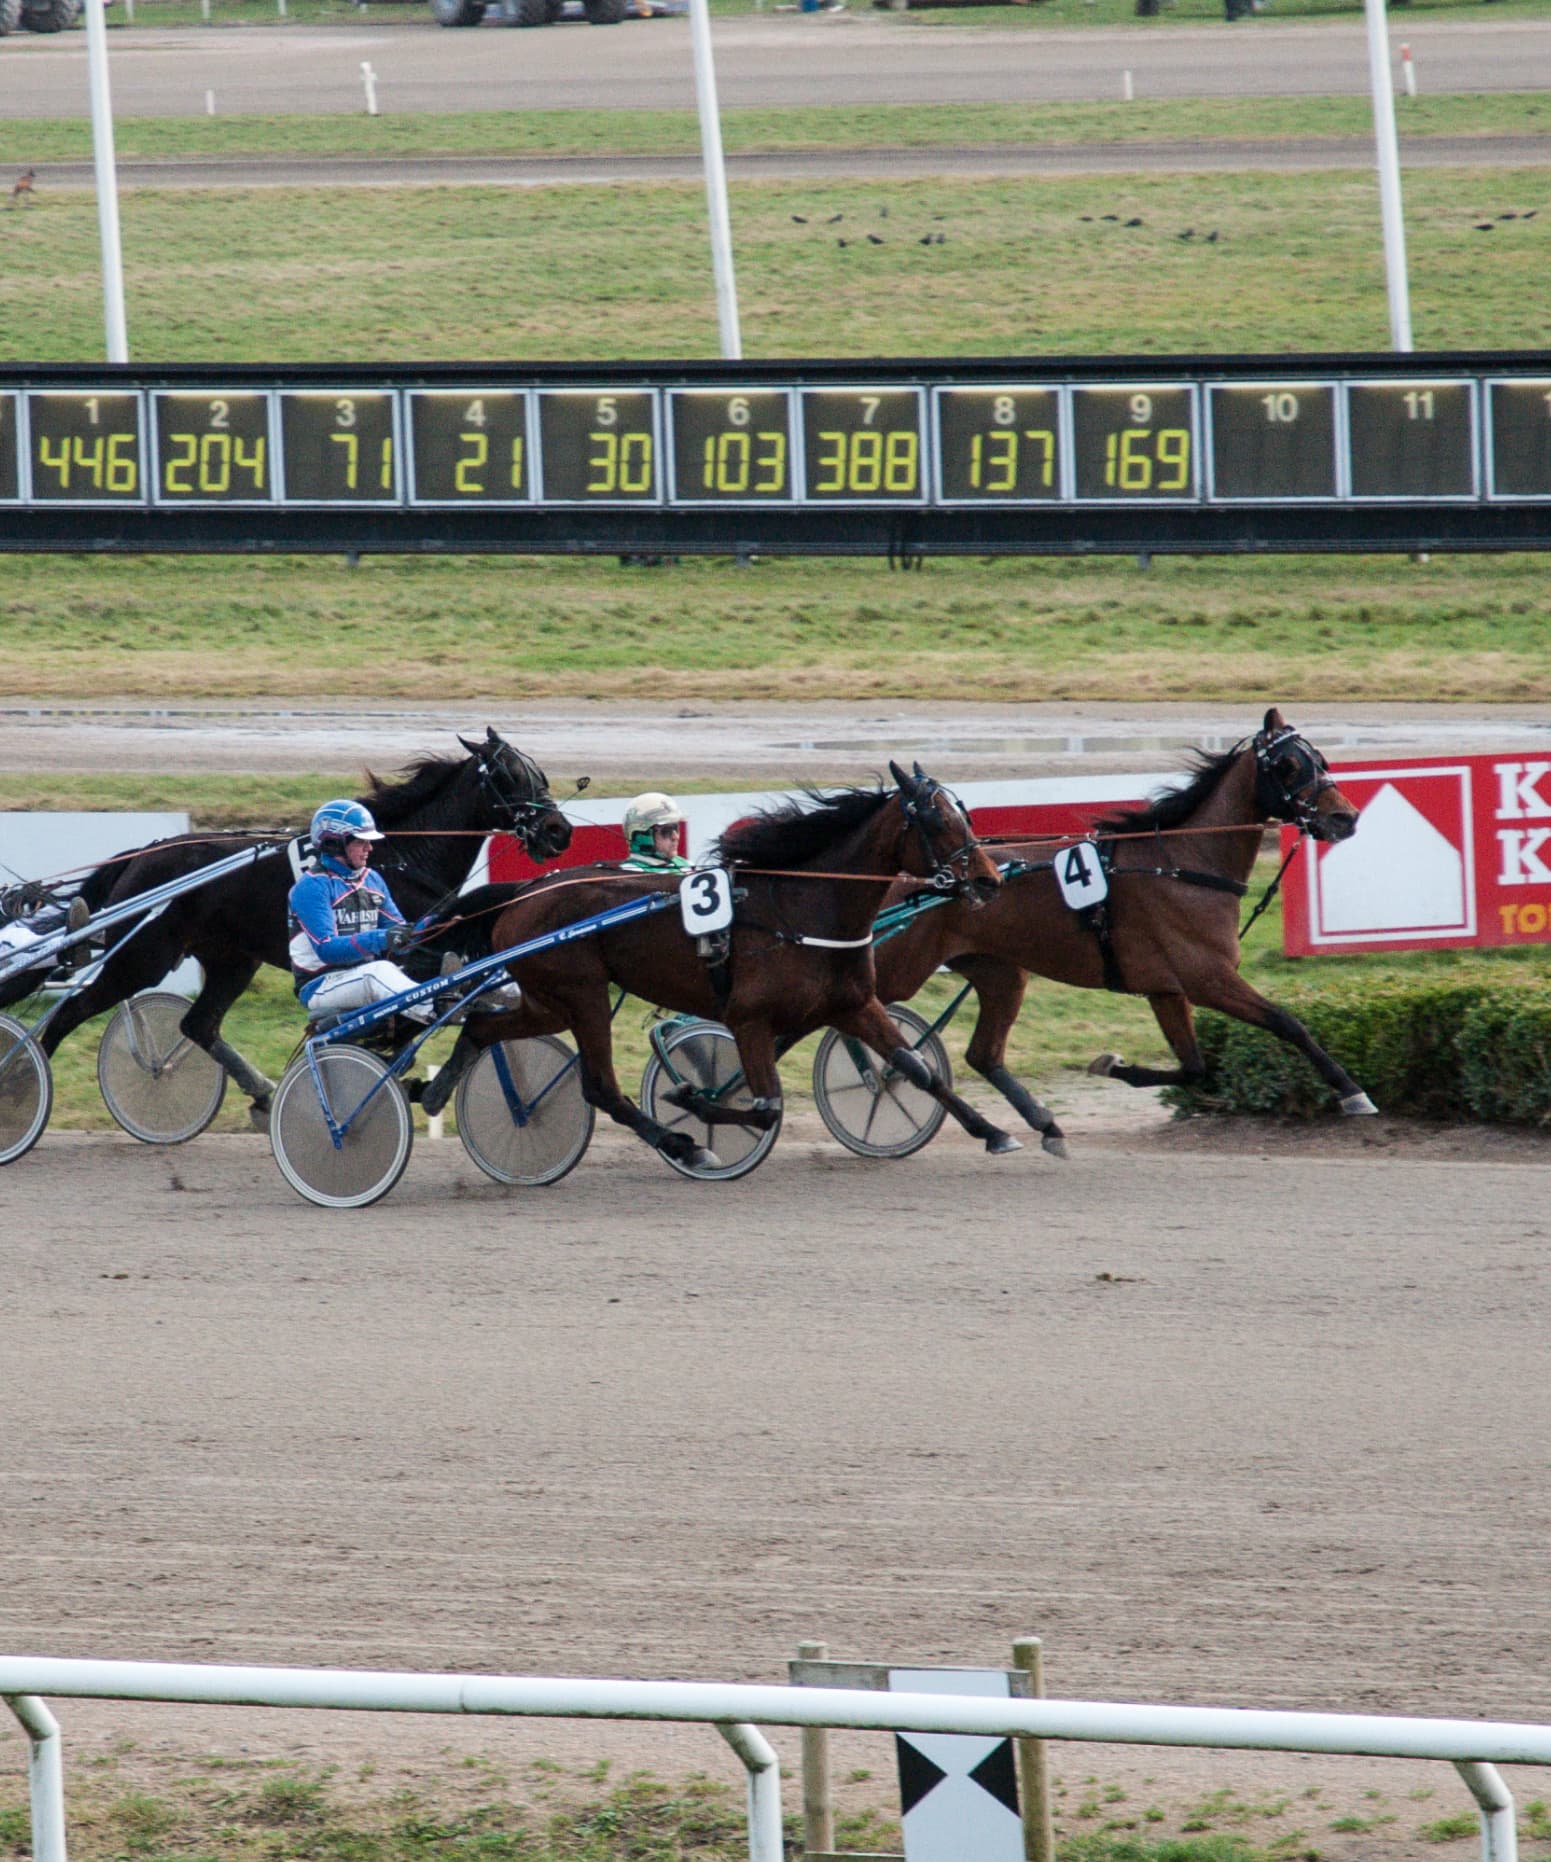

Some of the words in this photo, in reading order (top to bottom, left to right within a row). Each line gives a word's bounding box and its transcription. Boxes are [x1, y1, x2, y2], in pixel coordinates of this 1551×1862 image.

[84, 398, 99, 425] 1
[209, 400, 230, 429] 2
[335, 398, 357, 428] 3
[464, 399, 486, 427] 4
[597, 397, 618, 426] 5
[726, 396, 750, 427] 6
[858, 396, 881, 425] 7
[993, 395, 1016, 426] 8
[1129, 393, 1153, 424] 9
[1260, 392, 1299, 423] 10
[1402, 390, 1435, 421] 11
[39, 432, 138, 493] 446
[164, 433, 266, 493] 204
[328, 432, 394, 490] 71
[454, 432, 523, 493] 21
[586, 432, 653, 493] 30
[703, 431, 787, 492] 103
[814, 431, 919, 492] 388
[970, 429, 1055, 491] 137
[1105, 428, 1191, 491] 169
[1064, 845, 1092, 889] 4
[690, 872, 721, 917] 3
[405, 977, 449, 1003] CUSTOM
